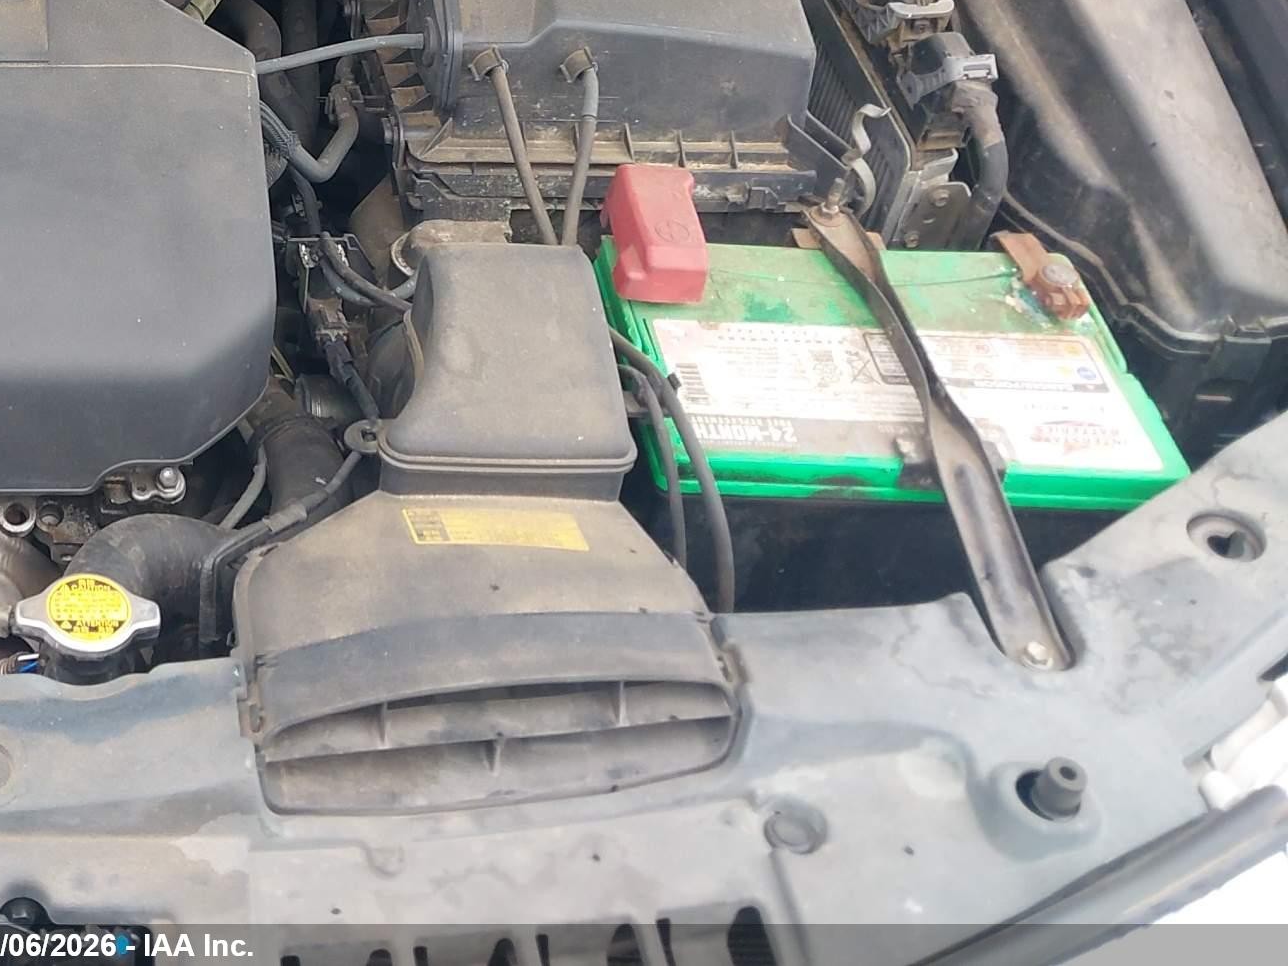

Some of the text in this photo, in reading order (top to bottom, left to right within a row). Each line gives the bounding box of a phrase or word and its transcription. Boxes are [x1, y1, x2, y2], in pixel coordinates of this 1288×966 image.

[693, 423, 798, 443] 24-MONTH
[70, 583, 112, 592] CAUTION
[75, 620, 119, 628] ATTENTION
